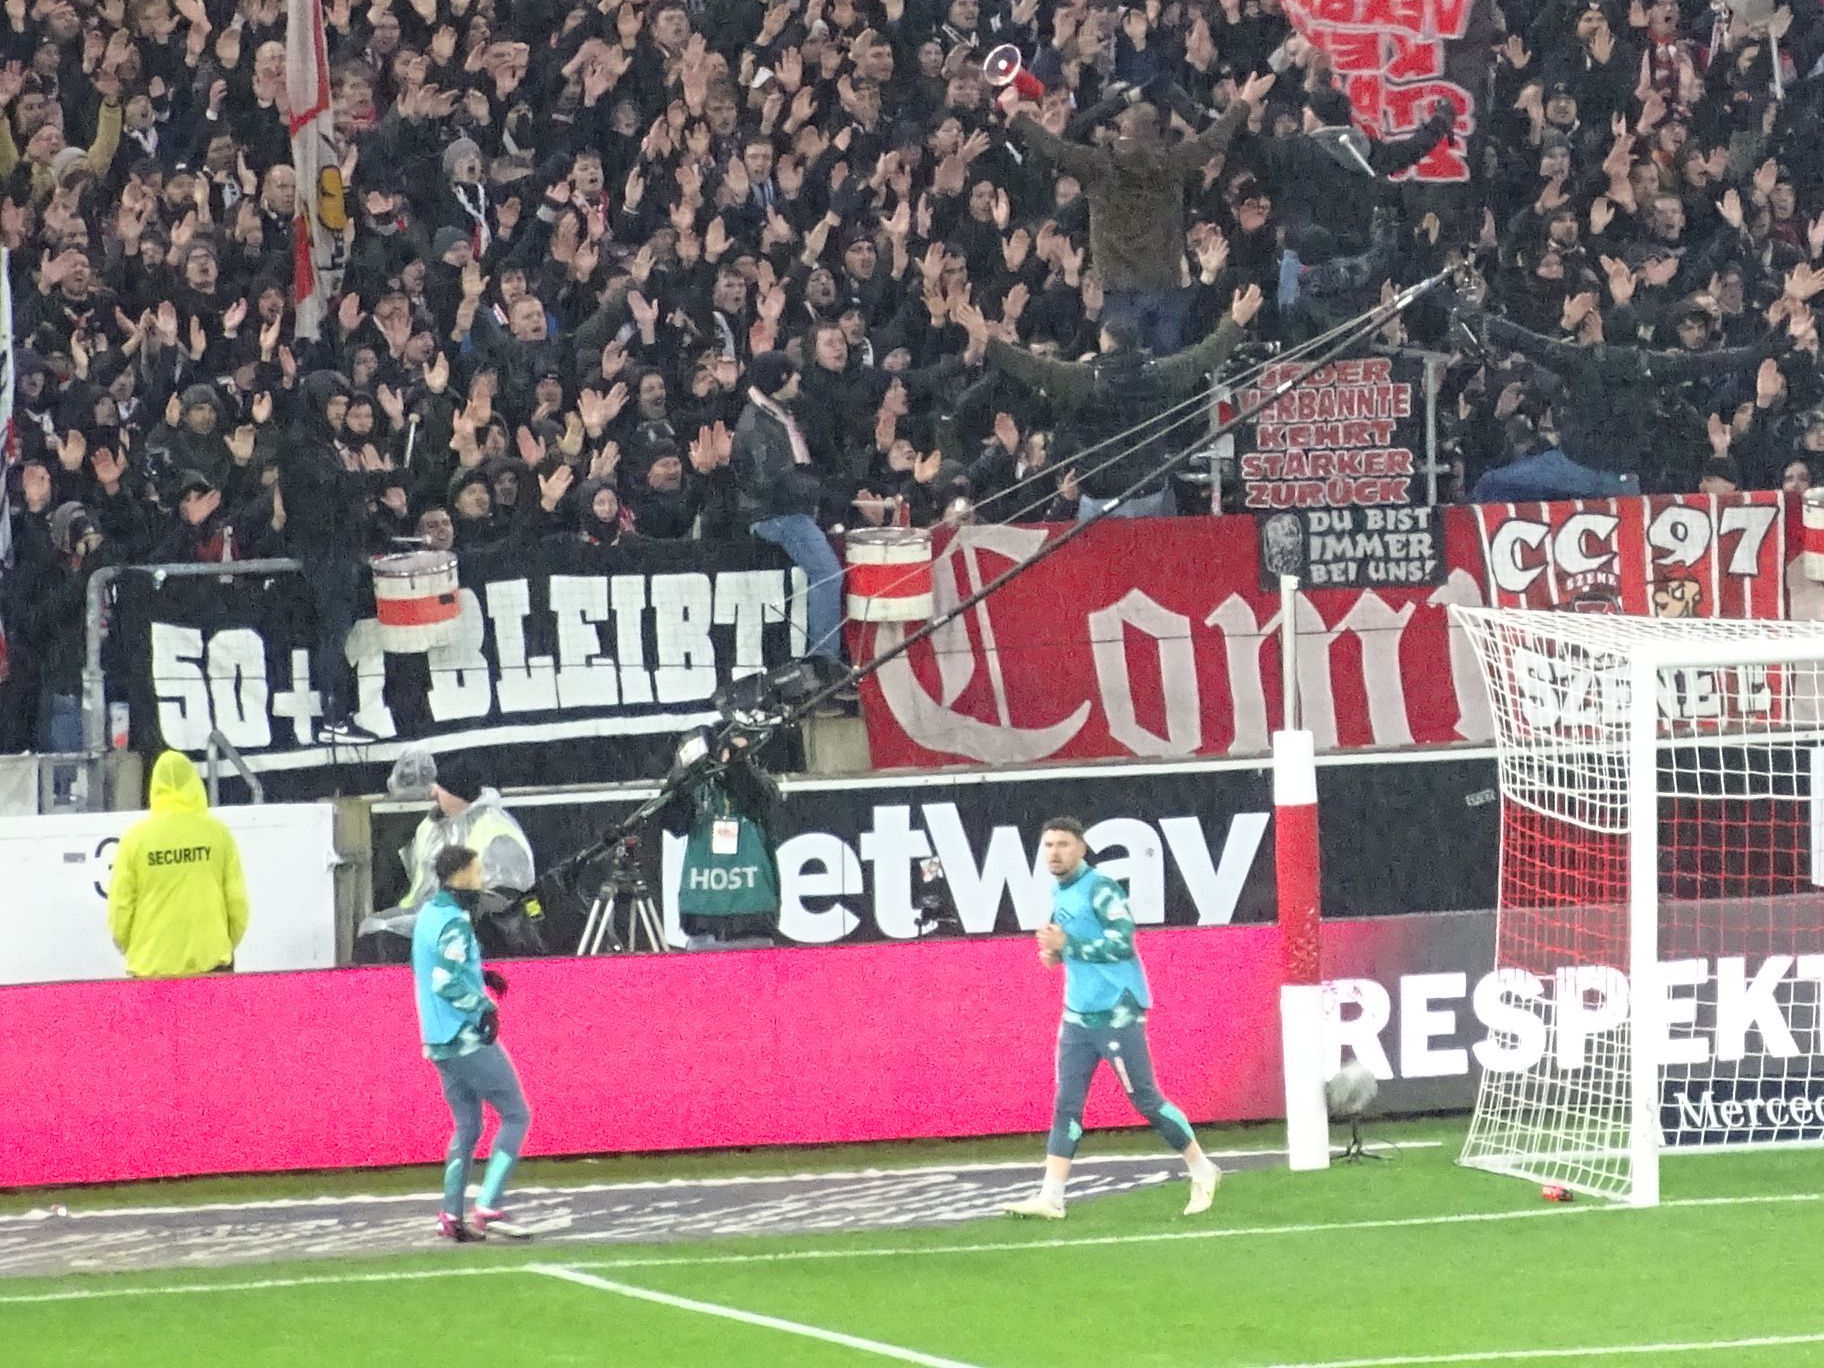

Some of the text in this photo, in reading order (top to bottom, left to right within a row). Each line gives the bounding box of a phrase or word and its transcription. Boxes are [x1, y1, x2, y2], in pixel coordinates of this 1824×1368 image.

[1239, 383, 1411, 423] VERBANNTE
[1257, 419, 1396, 450] KEHRT
[1308, 507, 1432, 532] DU BIST
[1309, 534, 1434, 560] IMMER
[1647, 503, 1781, 577] 97
[1310, 560, 1438, 583] BEI UNS!
[147, 846, 212, 867] SECURITY
[690, 866, 758, 890] HOST
